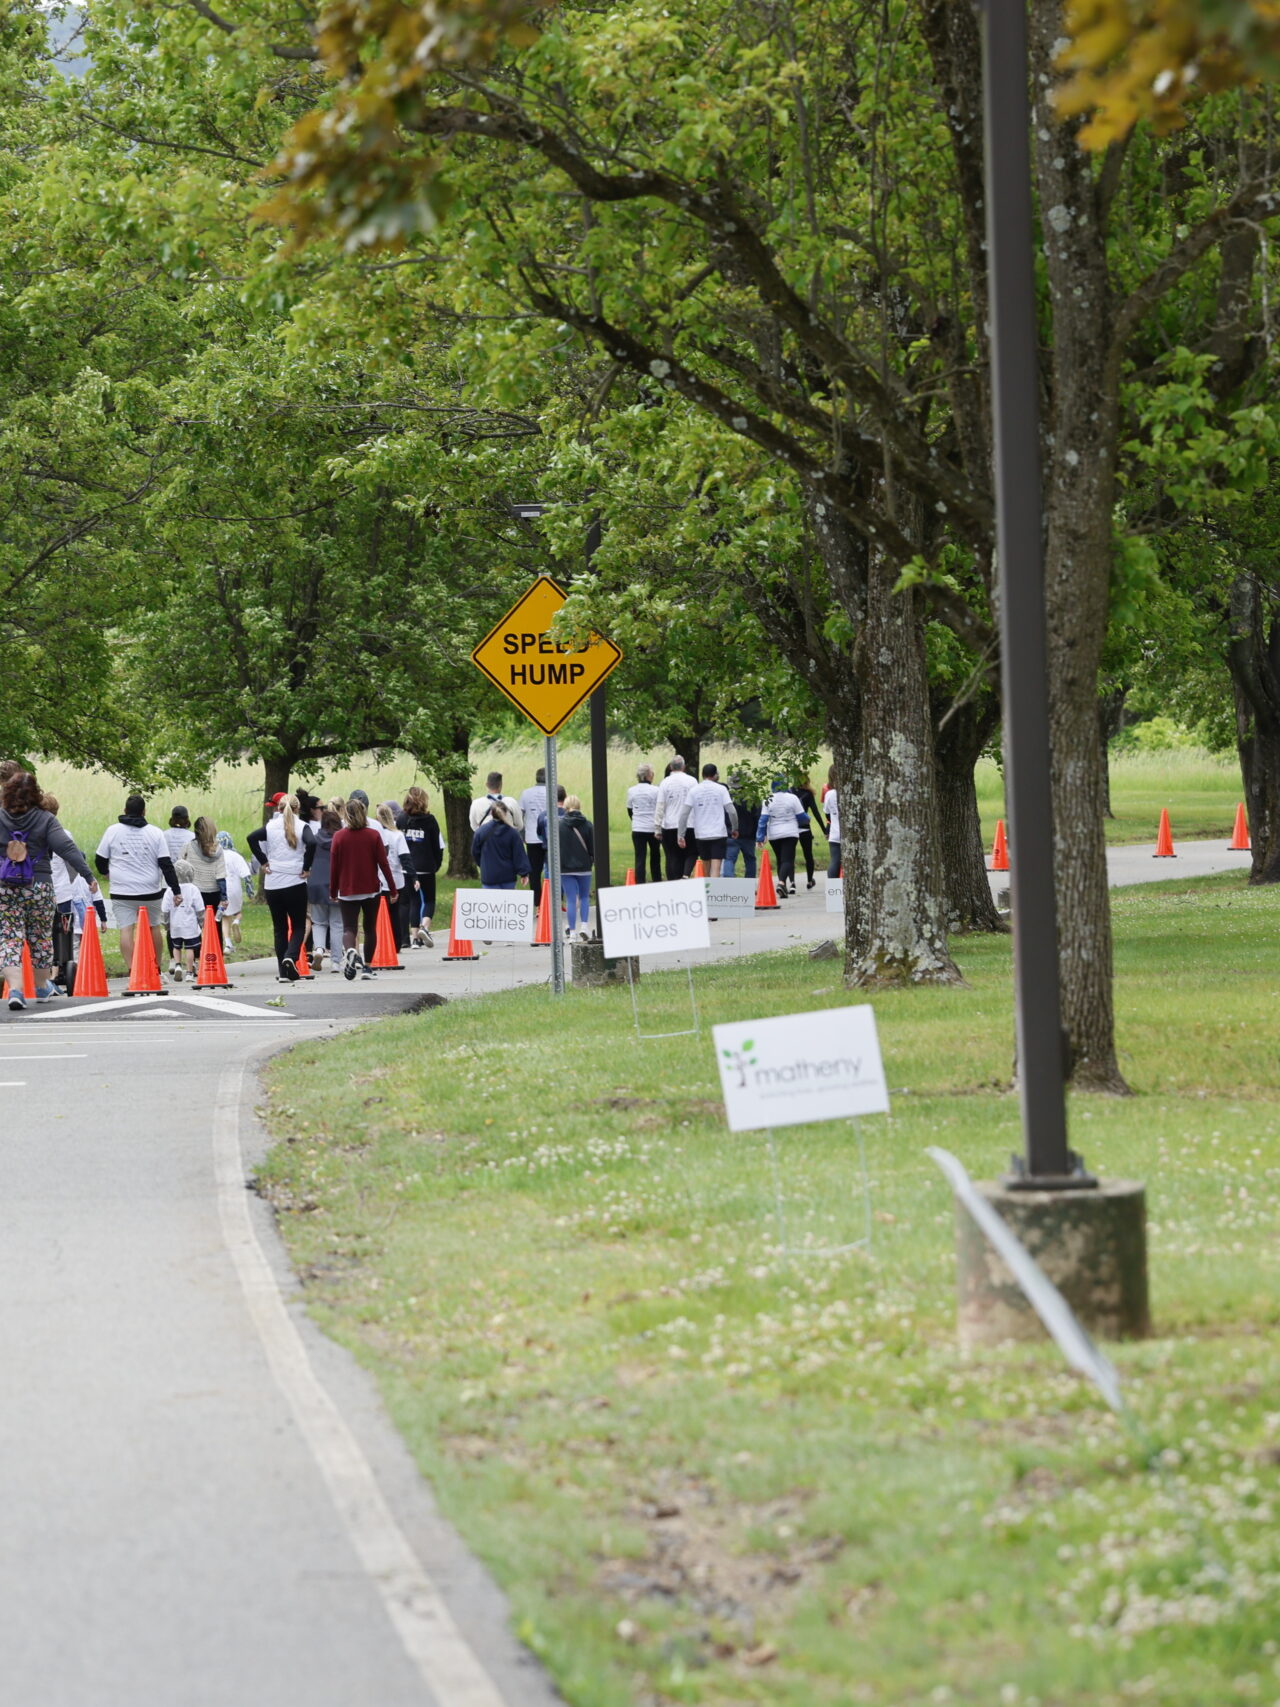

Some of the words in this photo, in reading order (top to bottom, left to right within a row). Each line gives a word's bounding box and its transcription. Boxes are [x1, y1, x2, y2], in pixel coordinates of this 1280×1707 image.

[510, 663, 585, 685] HUMP
[706, 892, 749, 903] matheny
[460, 900, 529, 918] growing
[604, 899, 704, 923] enriching
[463, 915, 526, 931] abilities
[633, 922, 678, 940] lives
[755, 1056, 863, 1085] matheny
